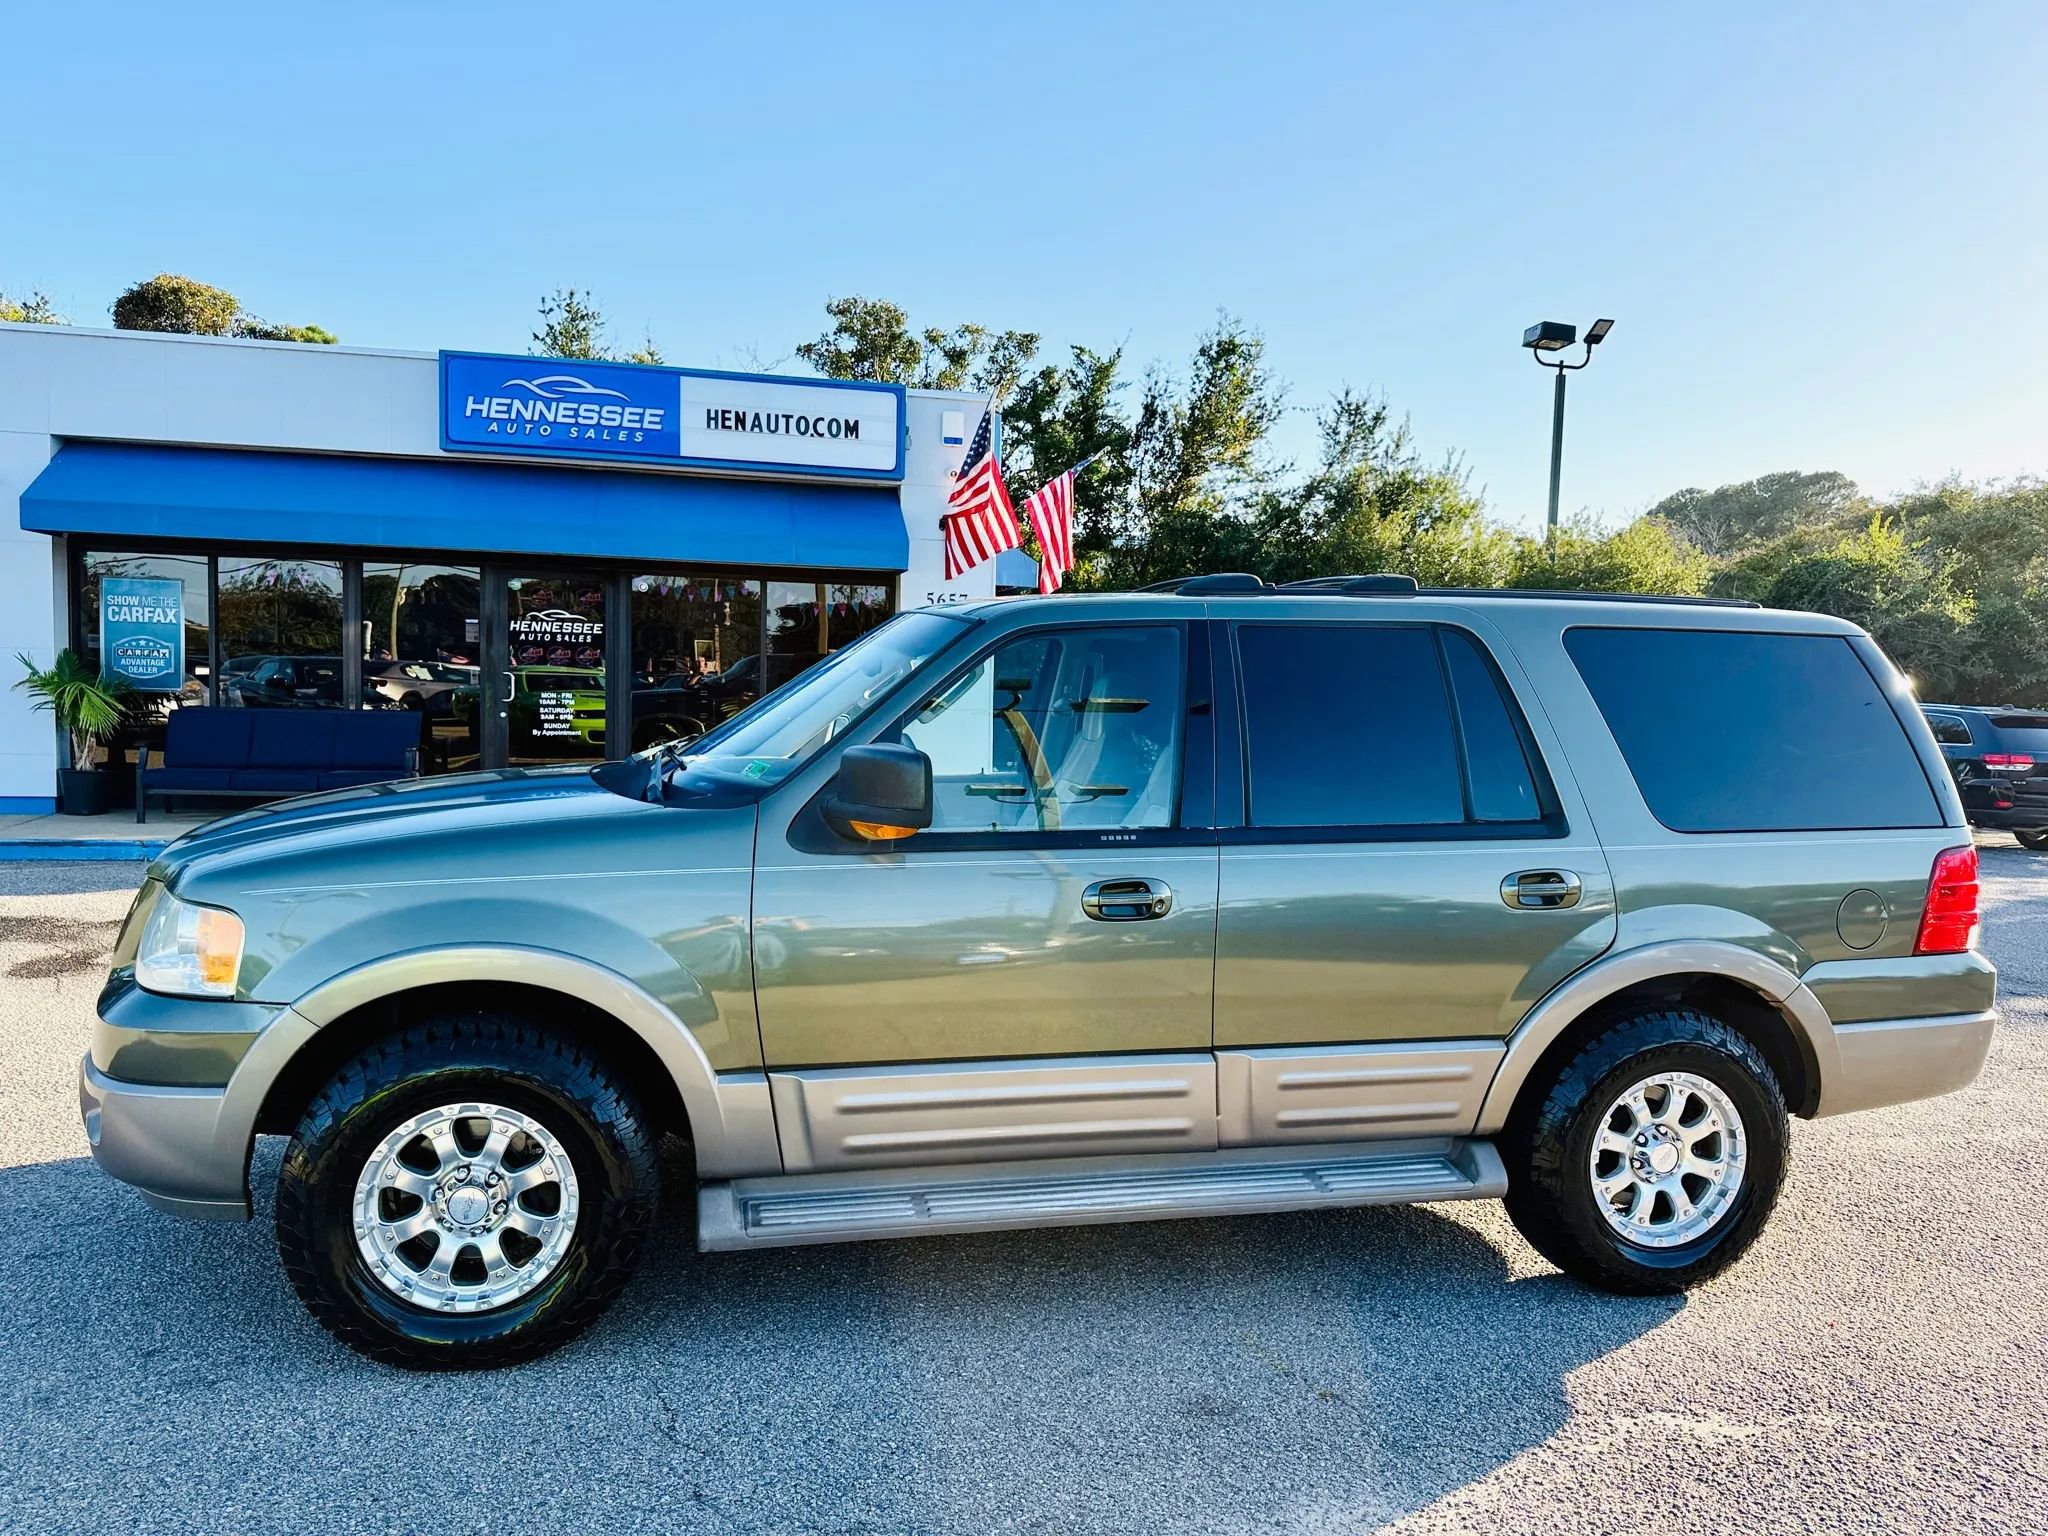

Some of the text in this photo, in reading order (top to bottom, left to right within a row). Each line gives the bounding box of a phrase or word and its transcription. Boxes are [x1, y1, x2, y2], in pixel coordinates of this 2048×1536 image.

[465, 396, 665, 430] HENNESSEE
[706, 408, 859, 439] HENAUTO.COM
[488, 421, 644, 442] AUTO SALES
[107, 595, 177, 608] SHOW ME THE
[107, 606, 178, 624] CARFAX
[509, 620, 604, 634] HENNESSEE
[519, 633, 592, 642] AUTO SALES
[117, 648, 169, 658] CARFAX
[120, 658, 166, 667] ADVANTAGE
[128, 665, 158, 674] DEALER
[532, 729, 582, 737] By Appointment
